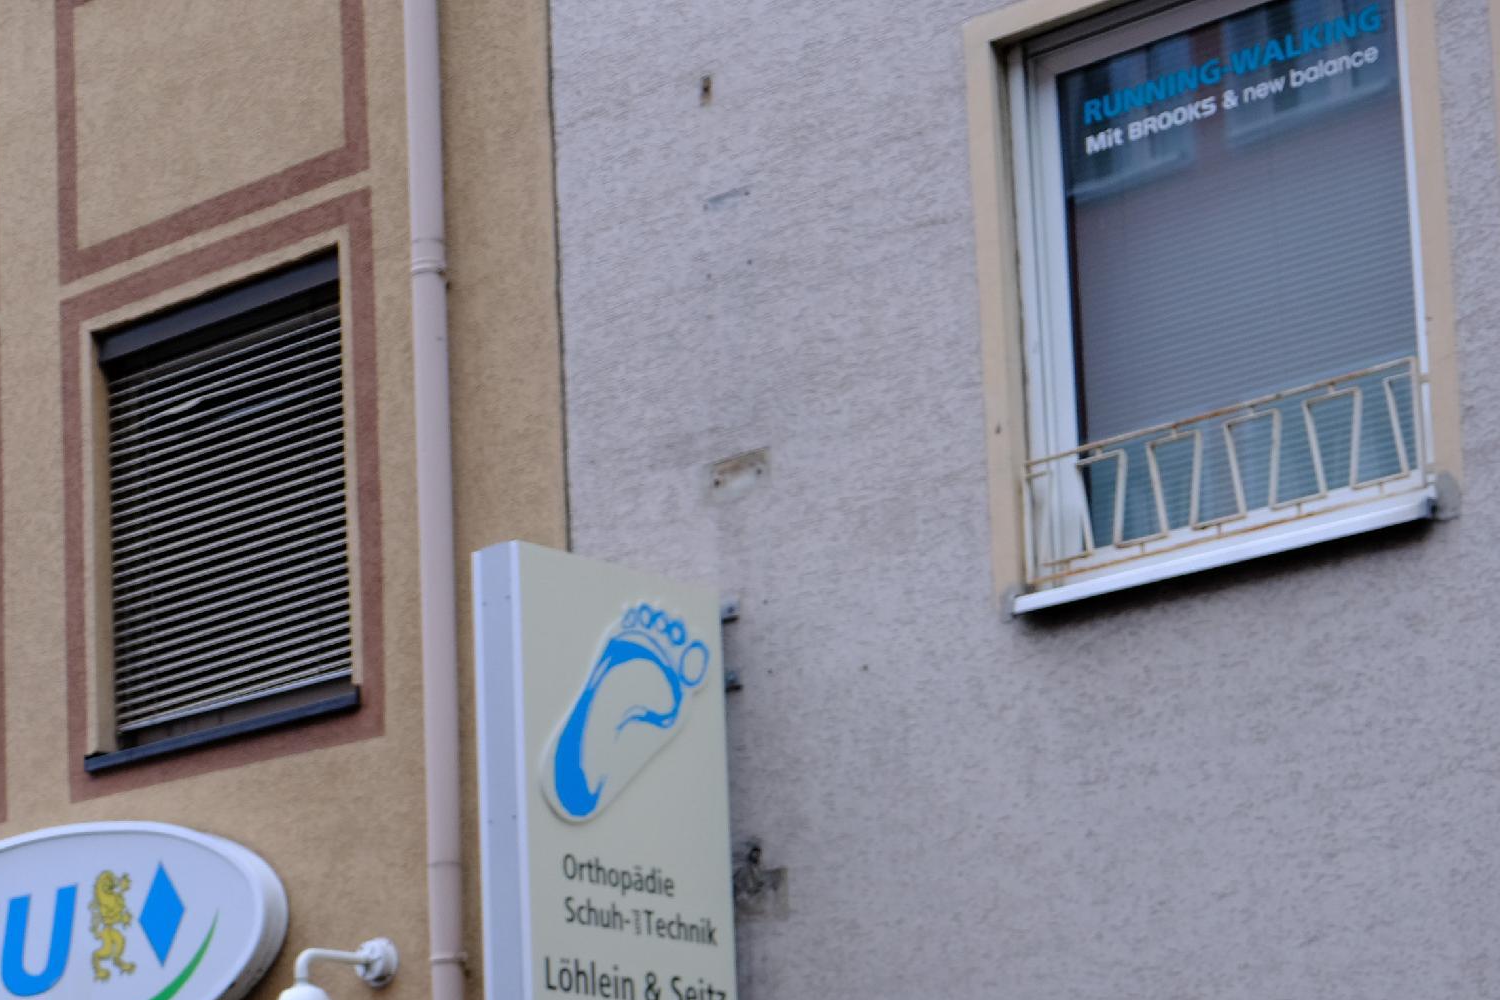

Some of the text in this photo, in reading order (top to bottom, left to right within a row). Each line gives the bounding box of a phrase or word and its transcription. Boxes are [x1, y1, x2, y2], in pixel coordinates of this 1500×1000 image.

[1083, 4, 1382, 124] RUNNING-WALKING
[1084, 45, 1380, 155] Mit BROOKS & new balance
[562, 853, 675, 897] Orthopädie
[564, 896, 631, 932] Schuh-
[644, 909, 718, 946] Technik
